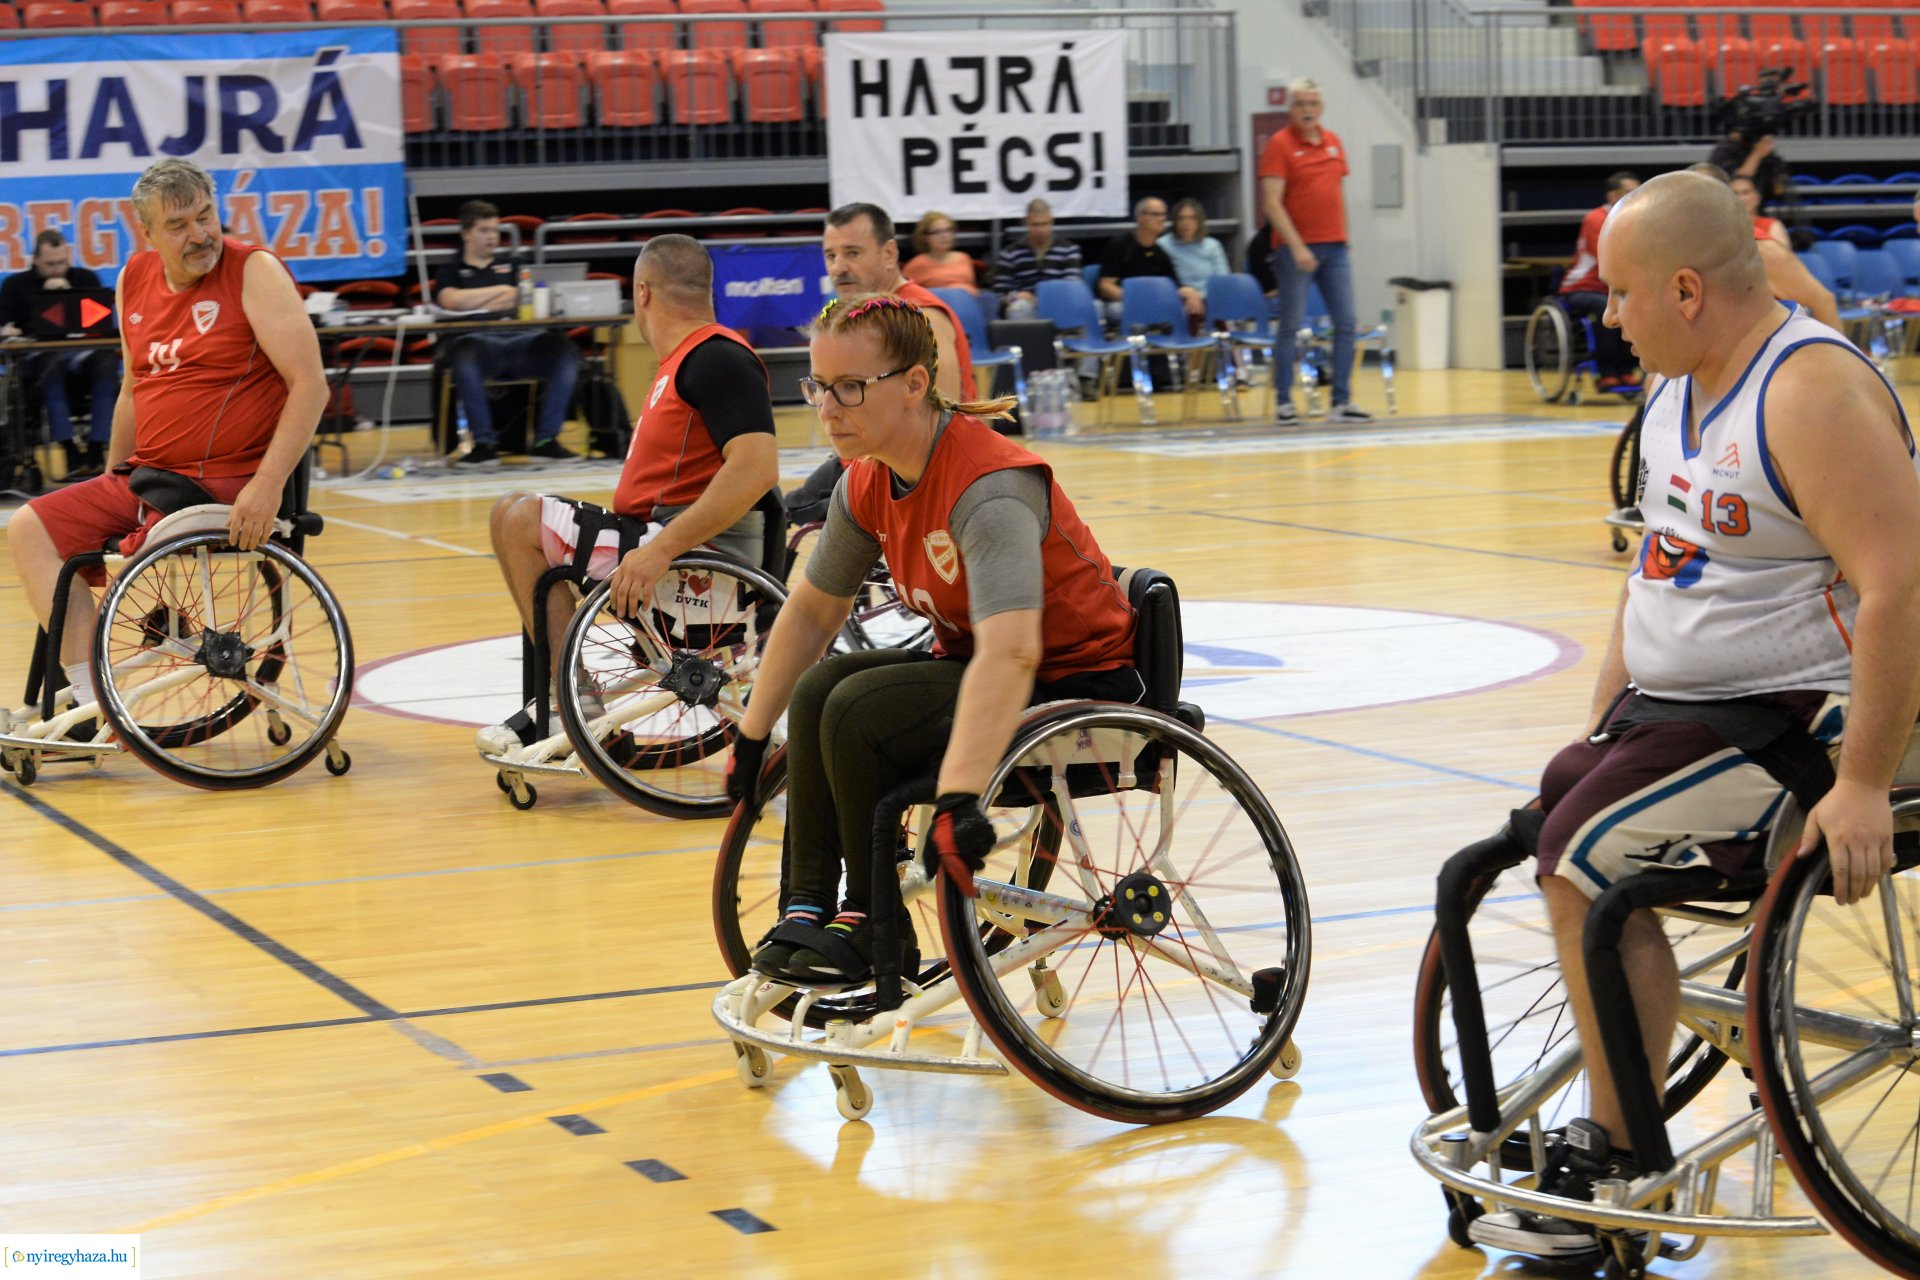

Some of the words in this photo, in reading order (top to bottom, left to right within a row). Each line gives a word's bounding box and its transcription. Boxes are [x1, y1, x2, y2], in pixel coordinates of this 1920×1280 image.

[0, 47, 364, 162] HAJRÁ
[852, 42, 1081, 118] HAJRÁ
[902, 123, 1104, 196] PÉCS!
[0, 170, 386, 271] REGYÁZA!
[148, 338, 183, 375] 14
[1712, 467, 1740, 479] MCNUT
[1701, 489, 1751, 537] 13
[675, 595, 709, 608] DVTK
